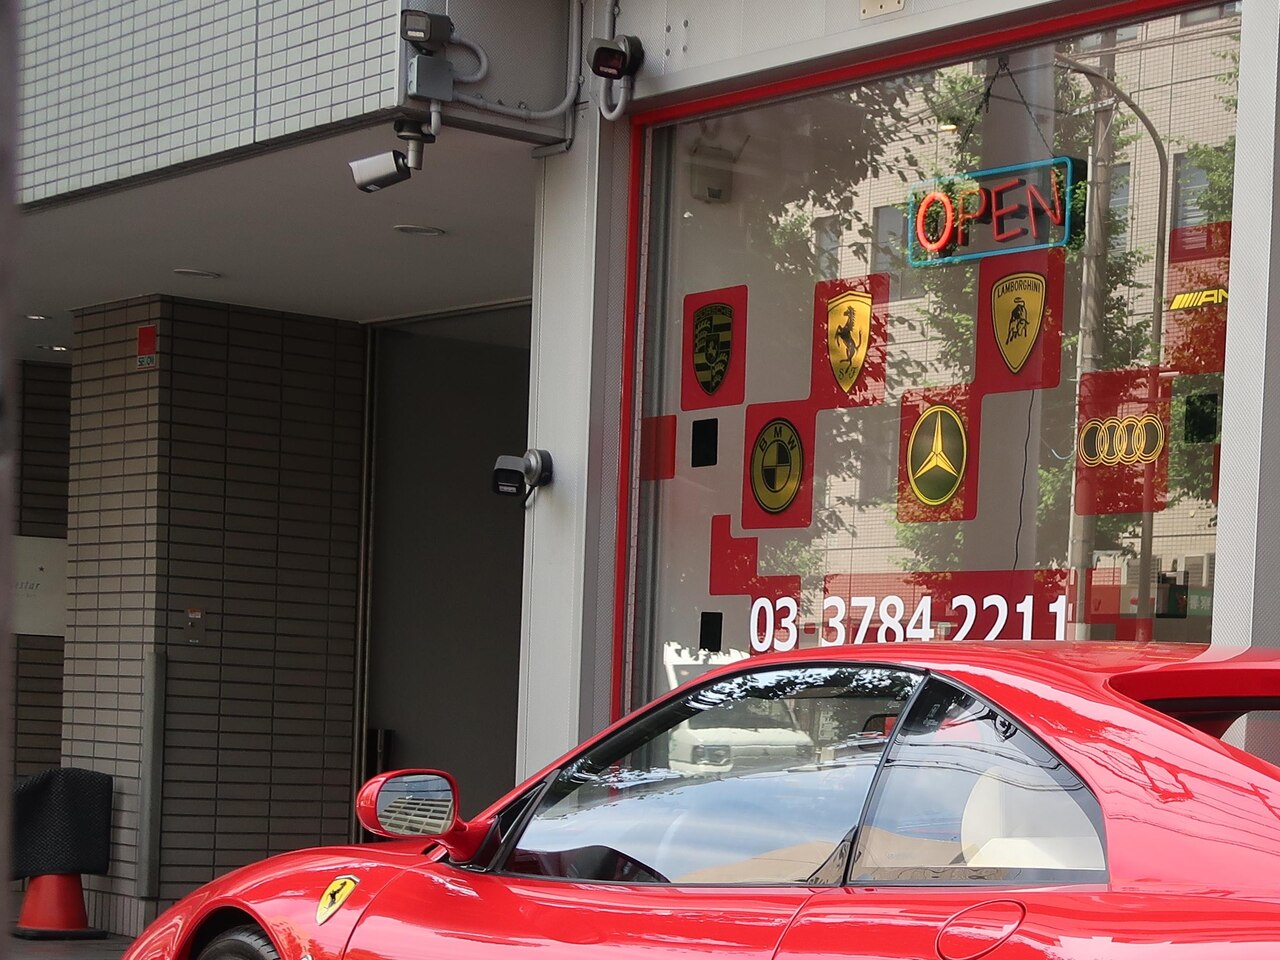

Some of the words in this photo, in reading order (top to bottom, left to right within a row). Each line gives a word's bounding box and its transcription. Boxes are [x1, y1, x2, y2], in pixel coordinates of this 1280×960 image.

[916, 170, 1063, 253] OPEN
[997, 280, 1041, 298] LAMBORGHINI
[759, 426, 797, 453] BMW
[749, 596, 799, 652] 03
